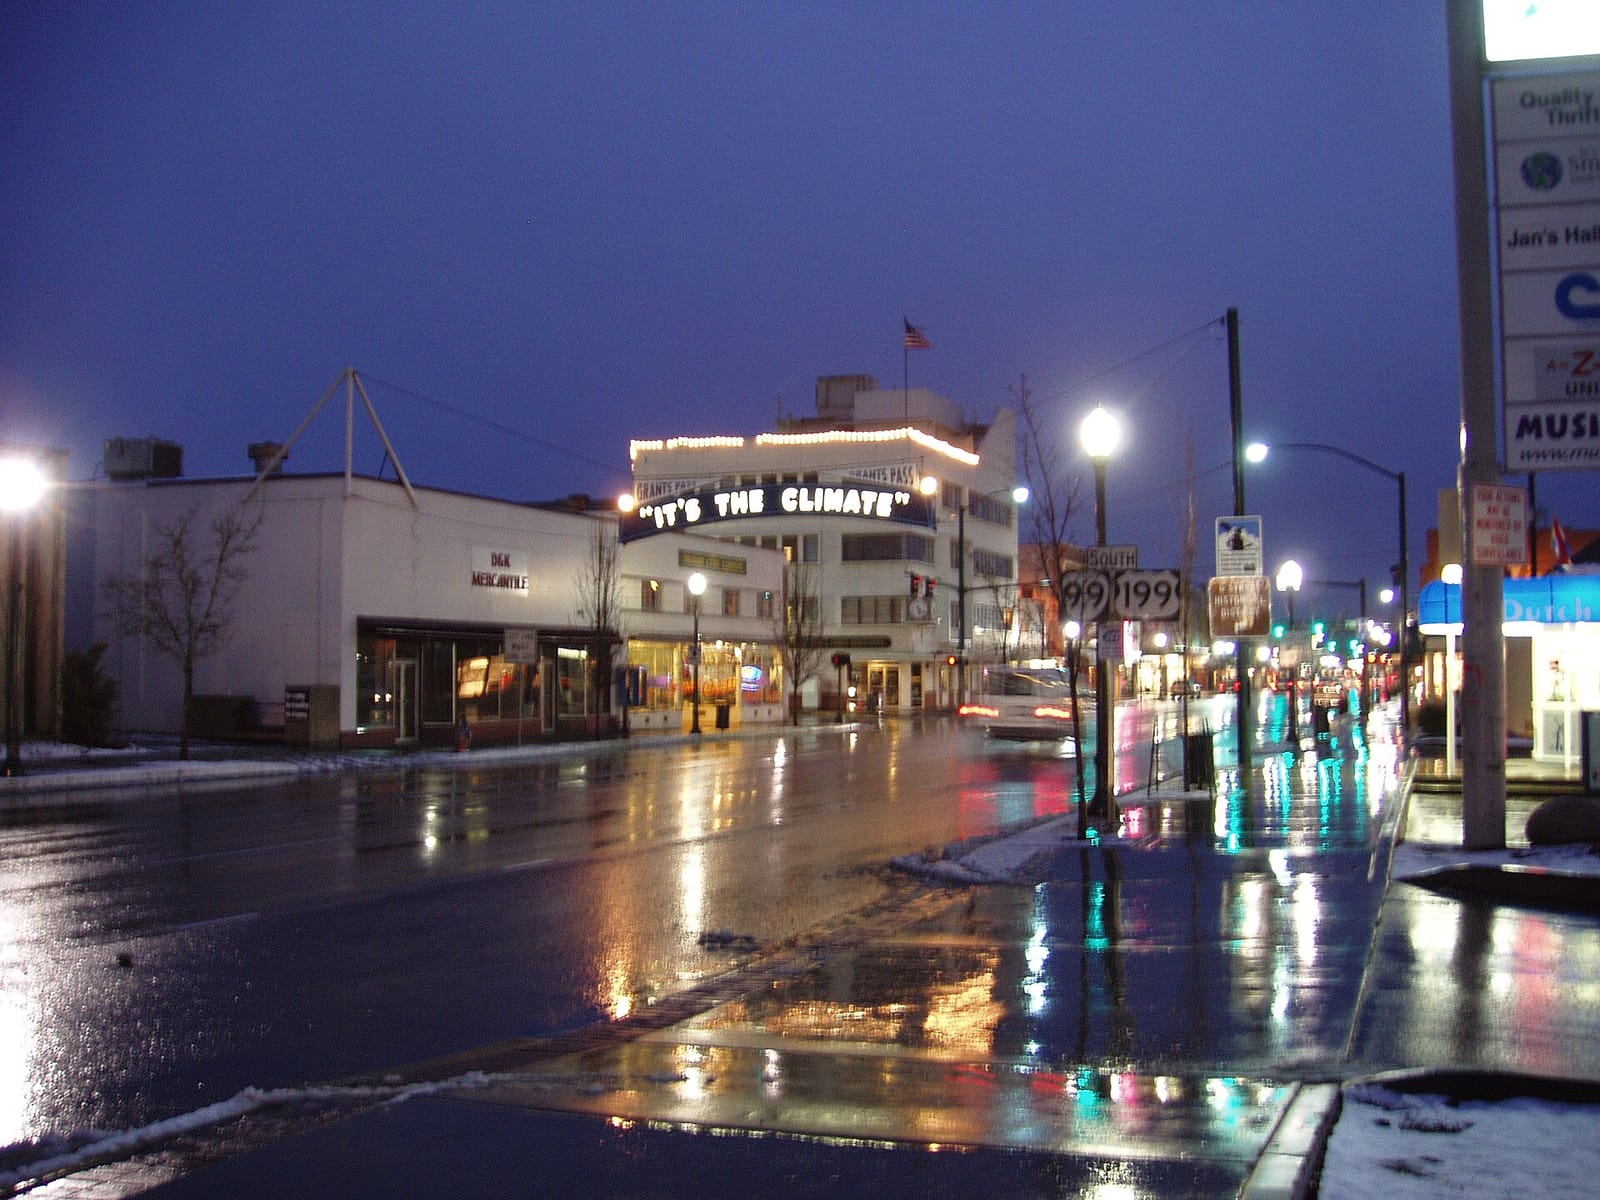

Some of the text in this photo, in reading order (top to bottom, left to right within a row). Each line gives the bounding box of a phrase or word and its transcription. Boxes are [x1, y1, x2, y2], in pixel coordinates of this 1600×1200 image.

[1520, 88, 1593, 107] Quality
[1508, 228, 1558, 247] Jan's
[1516, 411, 1600, 439] MUSI
[849, 465, 914, 485] GRANTS PASS
[637, 481, 673, 501] GRANTS
[714, 488, 765, 517] THE
[1089, 552, 1136, 567] SOUTH
[1063, 580, 1104, 608] 99
[1123, 580, 1172, 608] 199
[1505, 597, 1591, 621] Dutch
